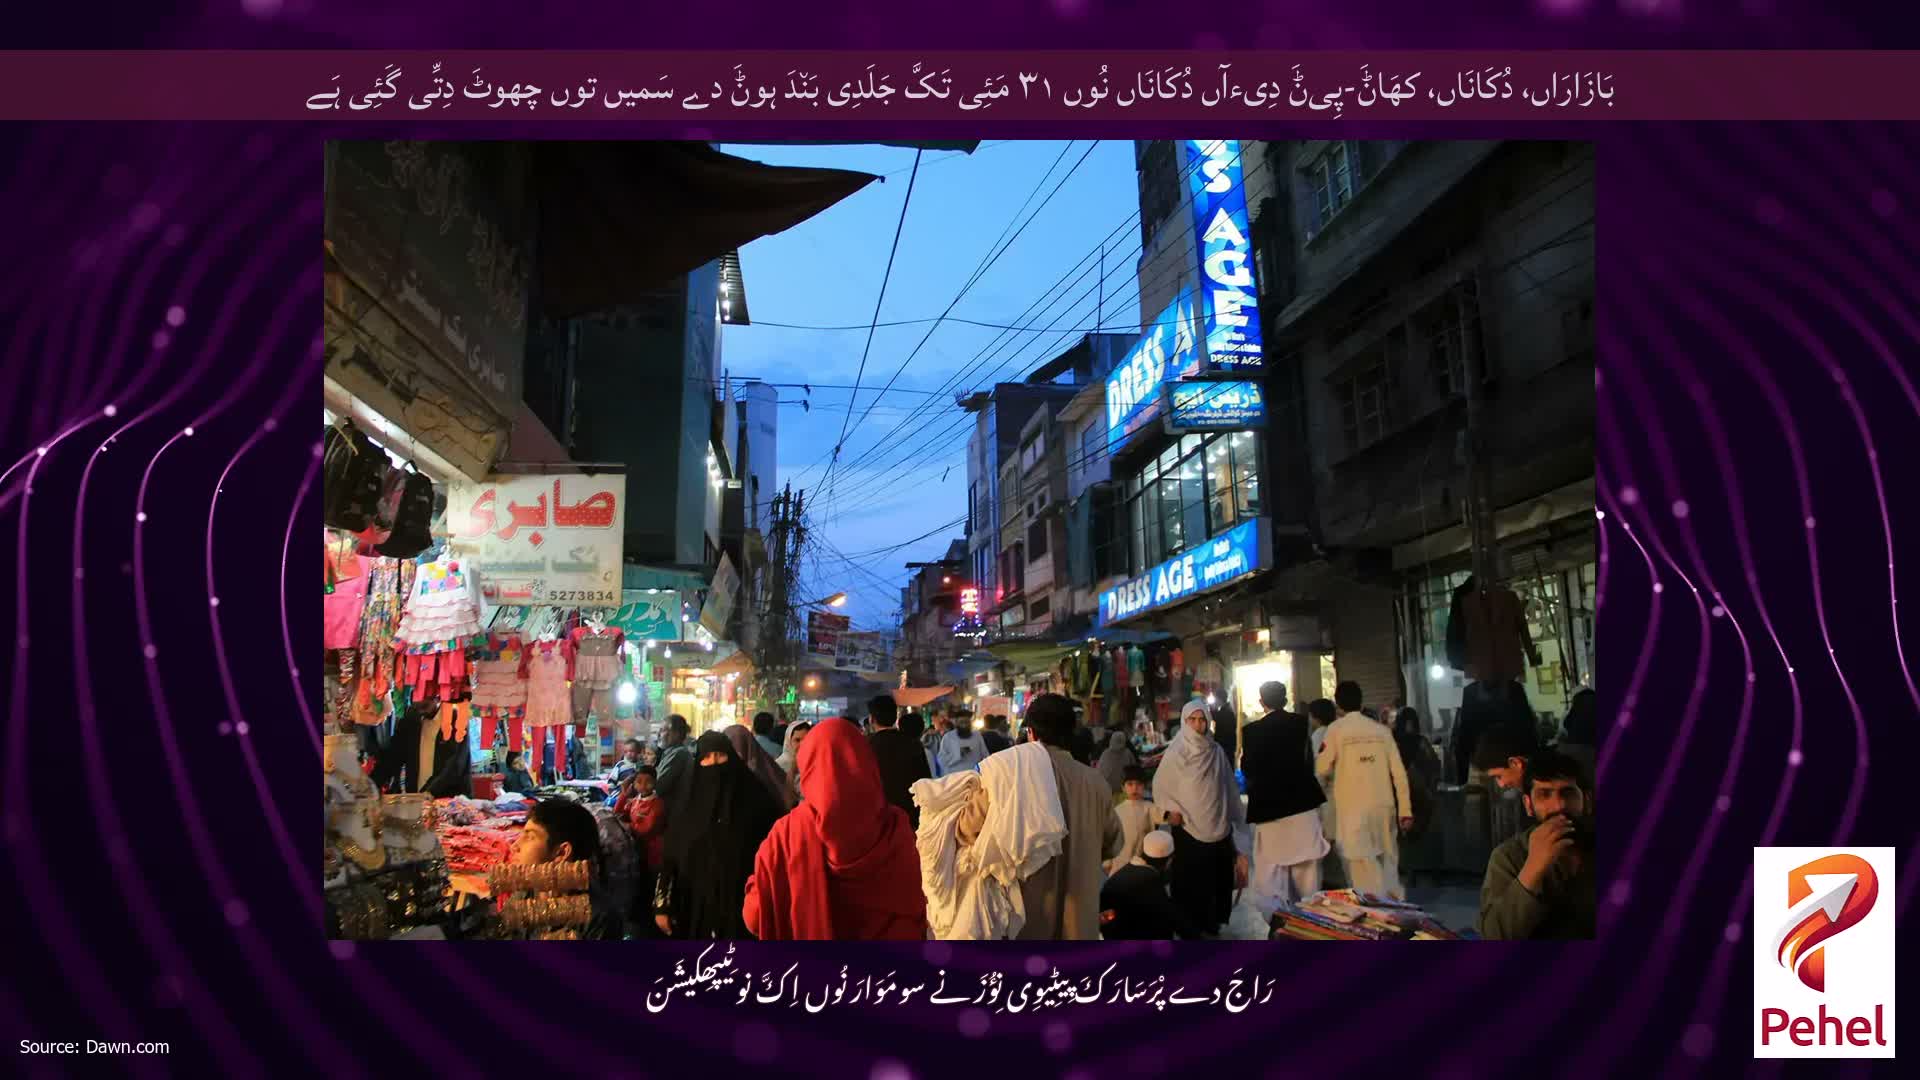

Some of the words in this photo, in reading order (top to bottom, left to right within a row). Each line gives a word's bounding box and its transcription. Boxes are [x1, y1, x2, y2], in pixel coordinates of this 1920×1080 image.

[1203, 207, 1257, 327] AGE
[1107, 325, 1166, 431] DRESS
[455, 478, 617, 547] صابری
[549, 590, 615, 602] 5273834
[1107, 572, 1151, 620] DRESS
[1155, 554, 1195, 604] AGE
